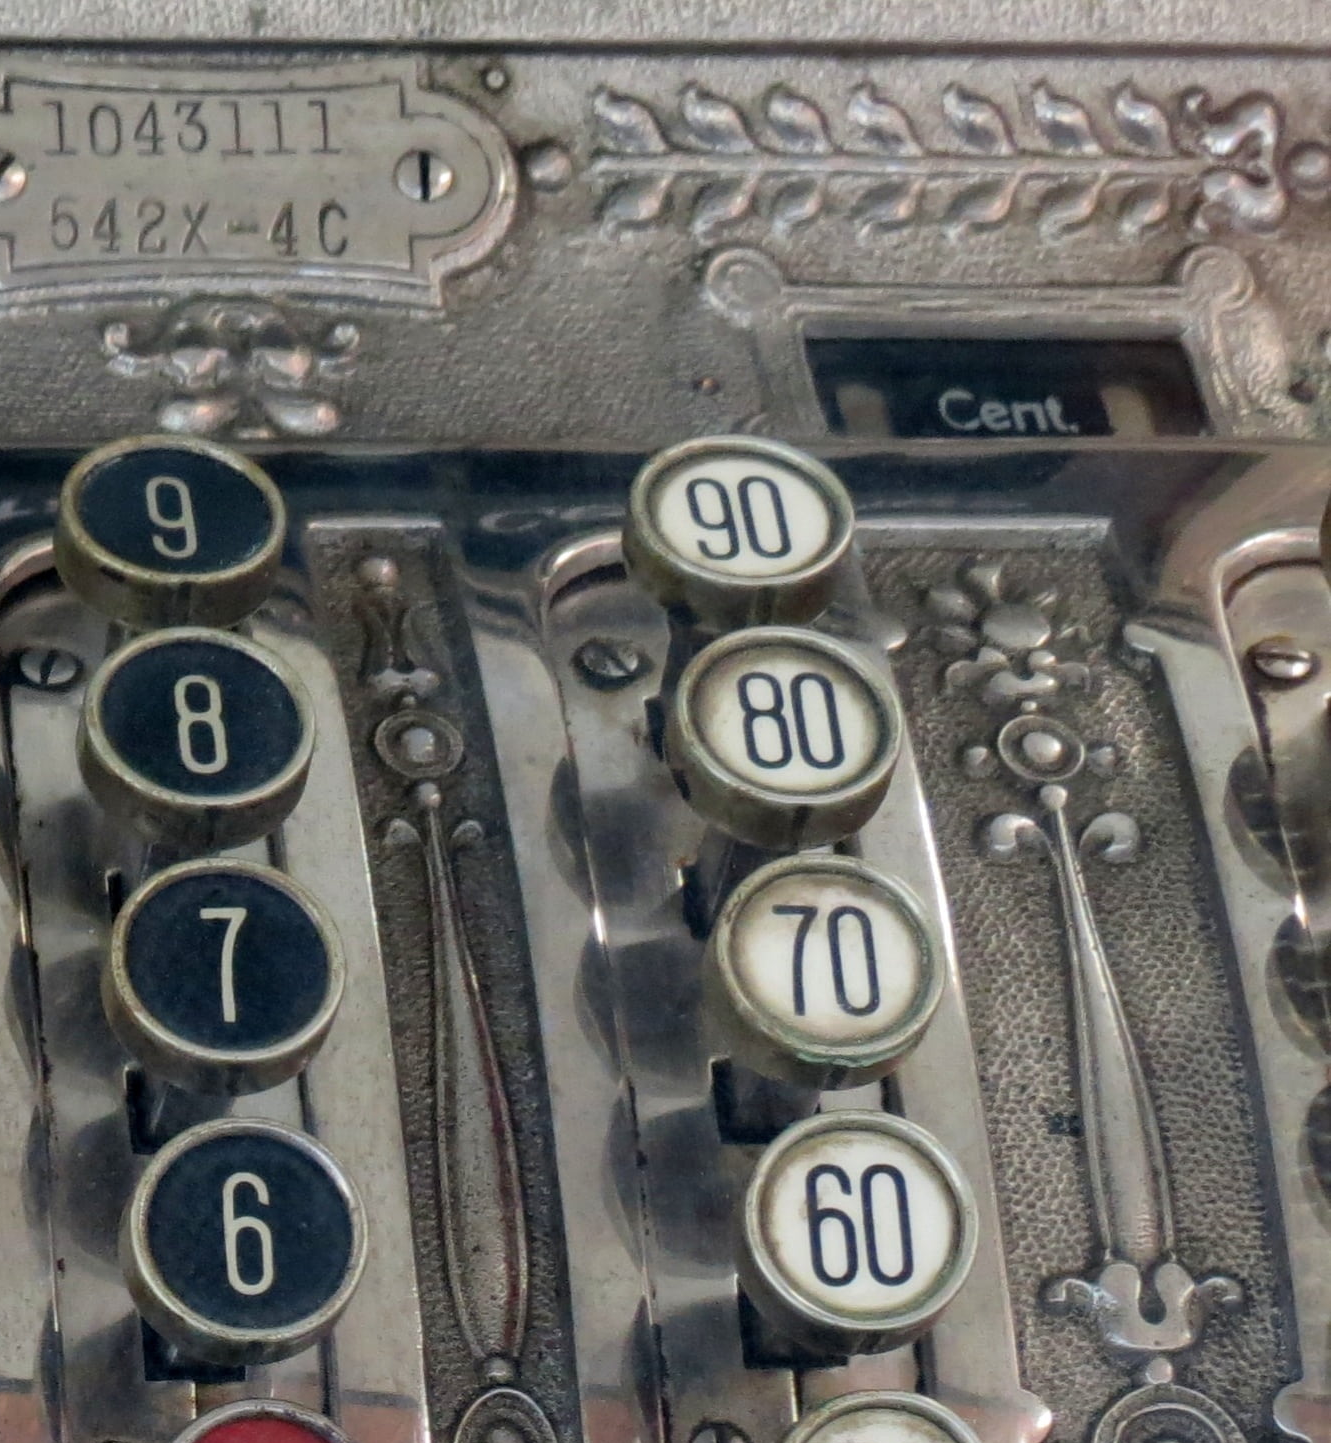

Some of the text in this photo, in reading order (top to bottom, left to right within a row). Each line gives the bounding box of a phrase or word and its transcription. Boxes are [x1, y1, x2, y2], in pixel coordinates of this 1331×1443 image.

[42, 99, 343, 157] 1043111
[938, 388, 1080, 434] Cent.
[146, 476, 197, 558] 9
[686, 476, 791, 560] 90
[174, 675, 227, 774] 8
[736, 671, 845, 772] 80
[200, 907, 246, 1022] 7
[771, 900, 880, 1017] 70
[223, 1172, 274, 1295] 6
[805, 1164, 913, 1287] 60
